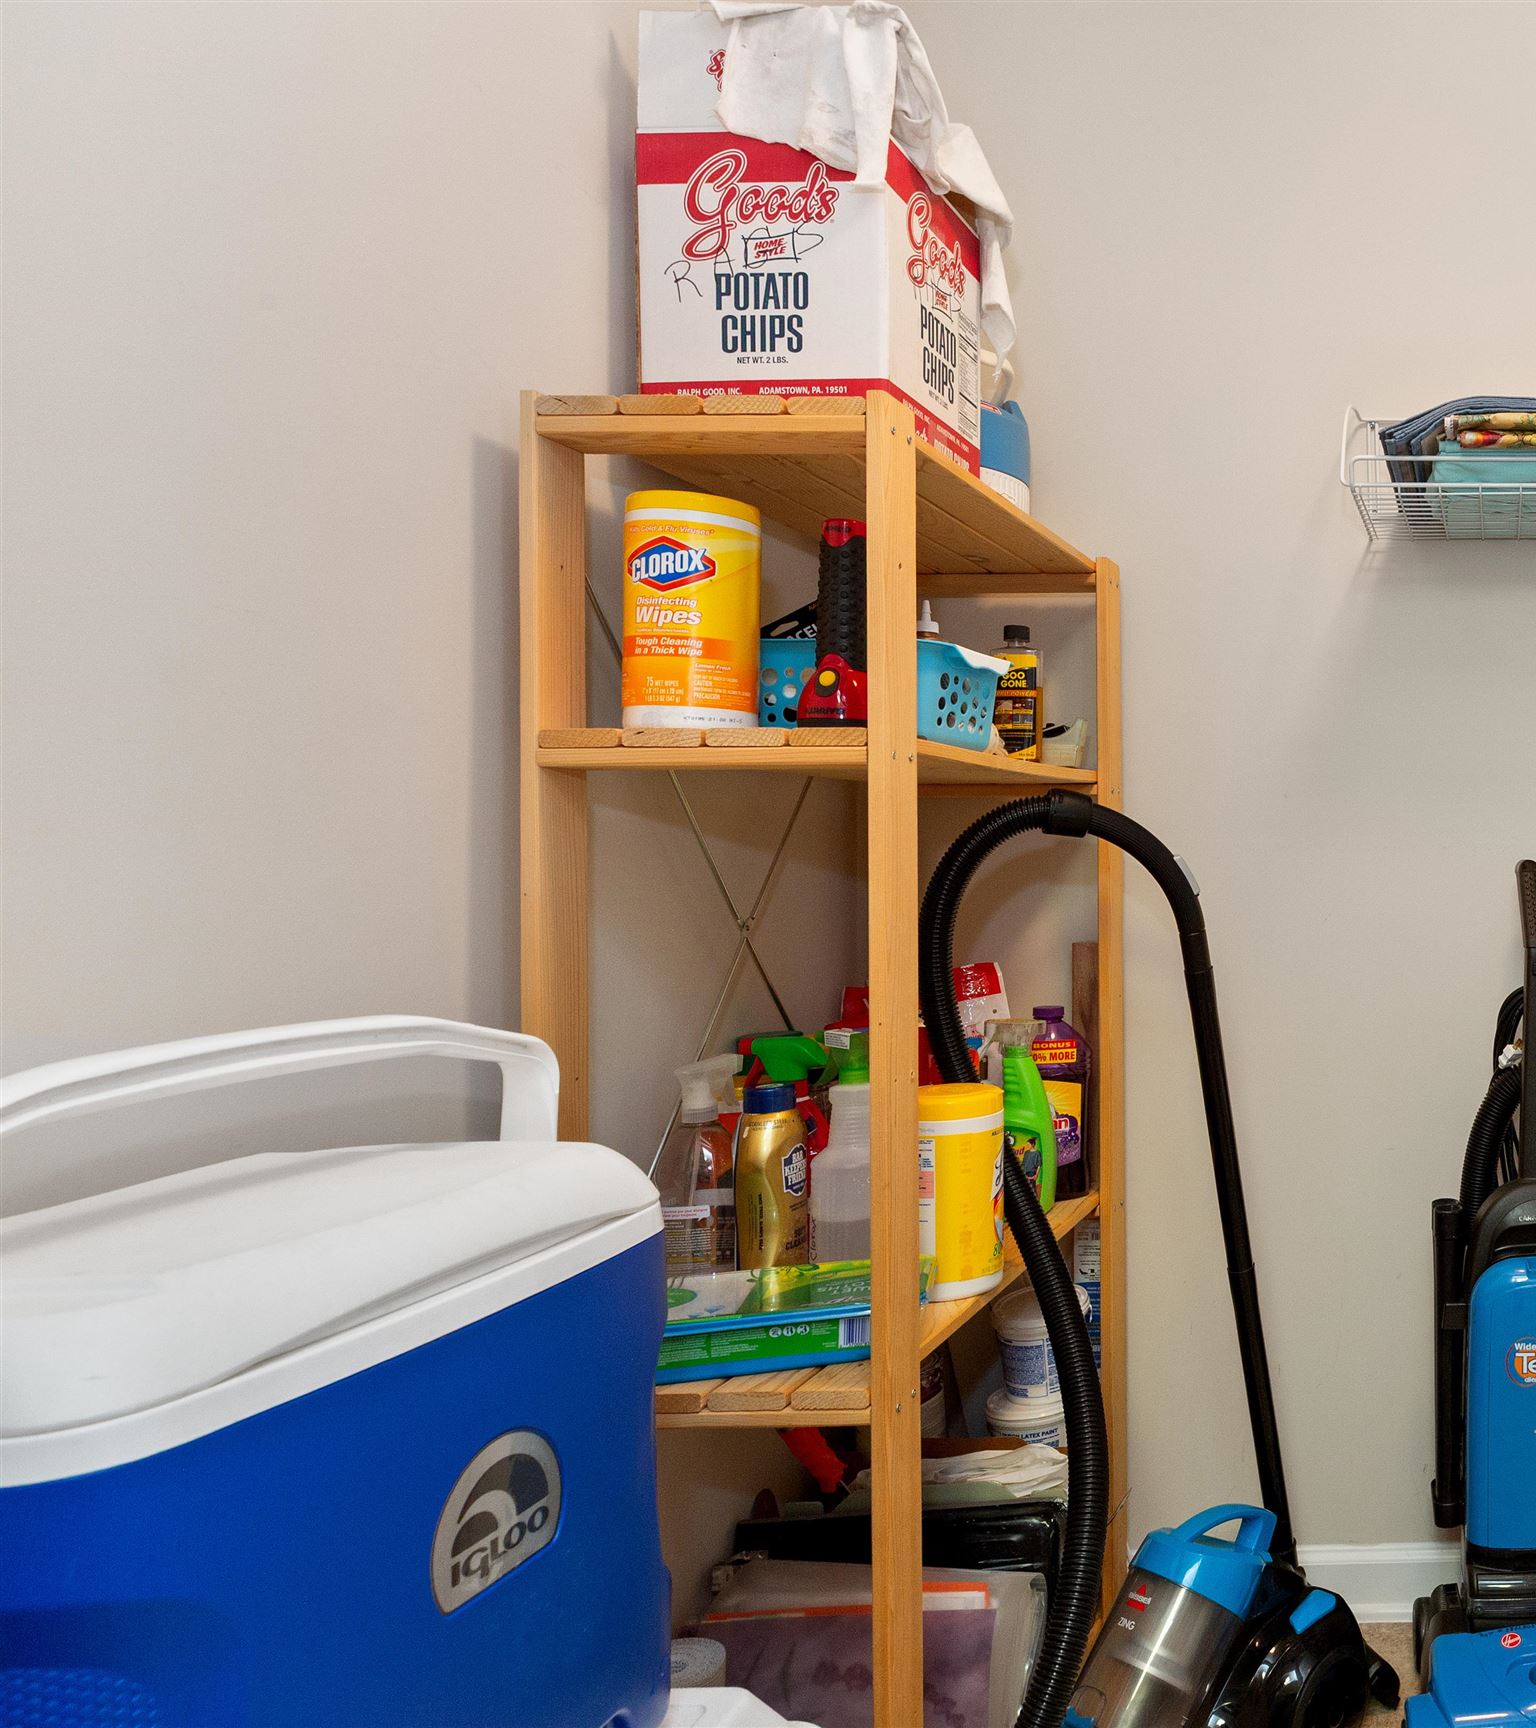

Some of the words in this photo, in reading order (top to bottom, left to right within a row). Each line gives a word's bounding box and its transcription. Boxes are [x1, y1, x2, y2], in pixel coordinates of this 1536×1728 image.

[681, 149, 840, 261] Good's
[754, 238, 785, 251] HOME
[905, 191, 967, 299] Good's
[754, 246, 787, 259] STYLE
[715, 271, 809, 311] POTATO
[721, 314, 803, 354] CHIPS
[920, 303, 957, 369] POTATO
[736, 356, 750, 364] NET
[752, 356, 765, 364] WT.
[922, 345, 955, 405] CHIPS
[677, 388, 701, 396] RALPH
[702, 387, 726, 396] GOOD,
[727, 387, 742, 395] INC.
[759, 386, 810, 395] ADAMSTOWN,
[811, 386, 823, 394] PA.
[825, 386, 848, 394] 19501
[631, 547, 707, 584] CLOROX
[636, 596, 697, 608] Disinfecting
[634, 605, 702, 627] Wipes
[635, 637, 659, 646] Tough
[660, 636, 703, 648] Cleaning
[635, 646, 641, 654] in
[651, 646, 675, 655] Thick
[678, 646, 703, 657] Wipe
[646, 676, 654, 687] 75
[1002, 671, 1026, 680] GOO
[1000, 680, 1027, 688] GONE
[1033, 1041, 1071, 1049] BONUS
[1049, 1050, 1076, 1061] MORE
[1020, 1429, 1039, 1439] LATEX
[1041, 1427, 1058, 1437] PAINT
[450, 1505, 550, 1589] IGLOO
[1117, 1616, 1136, 1631] ZING
